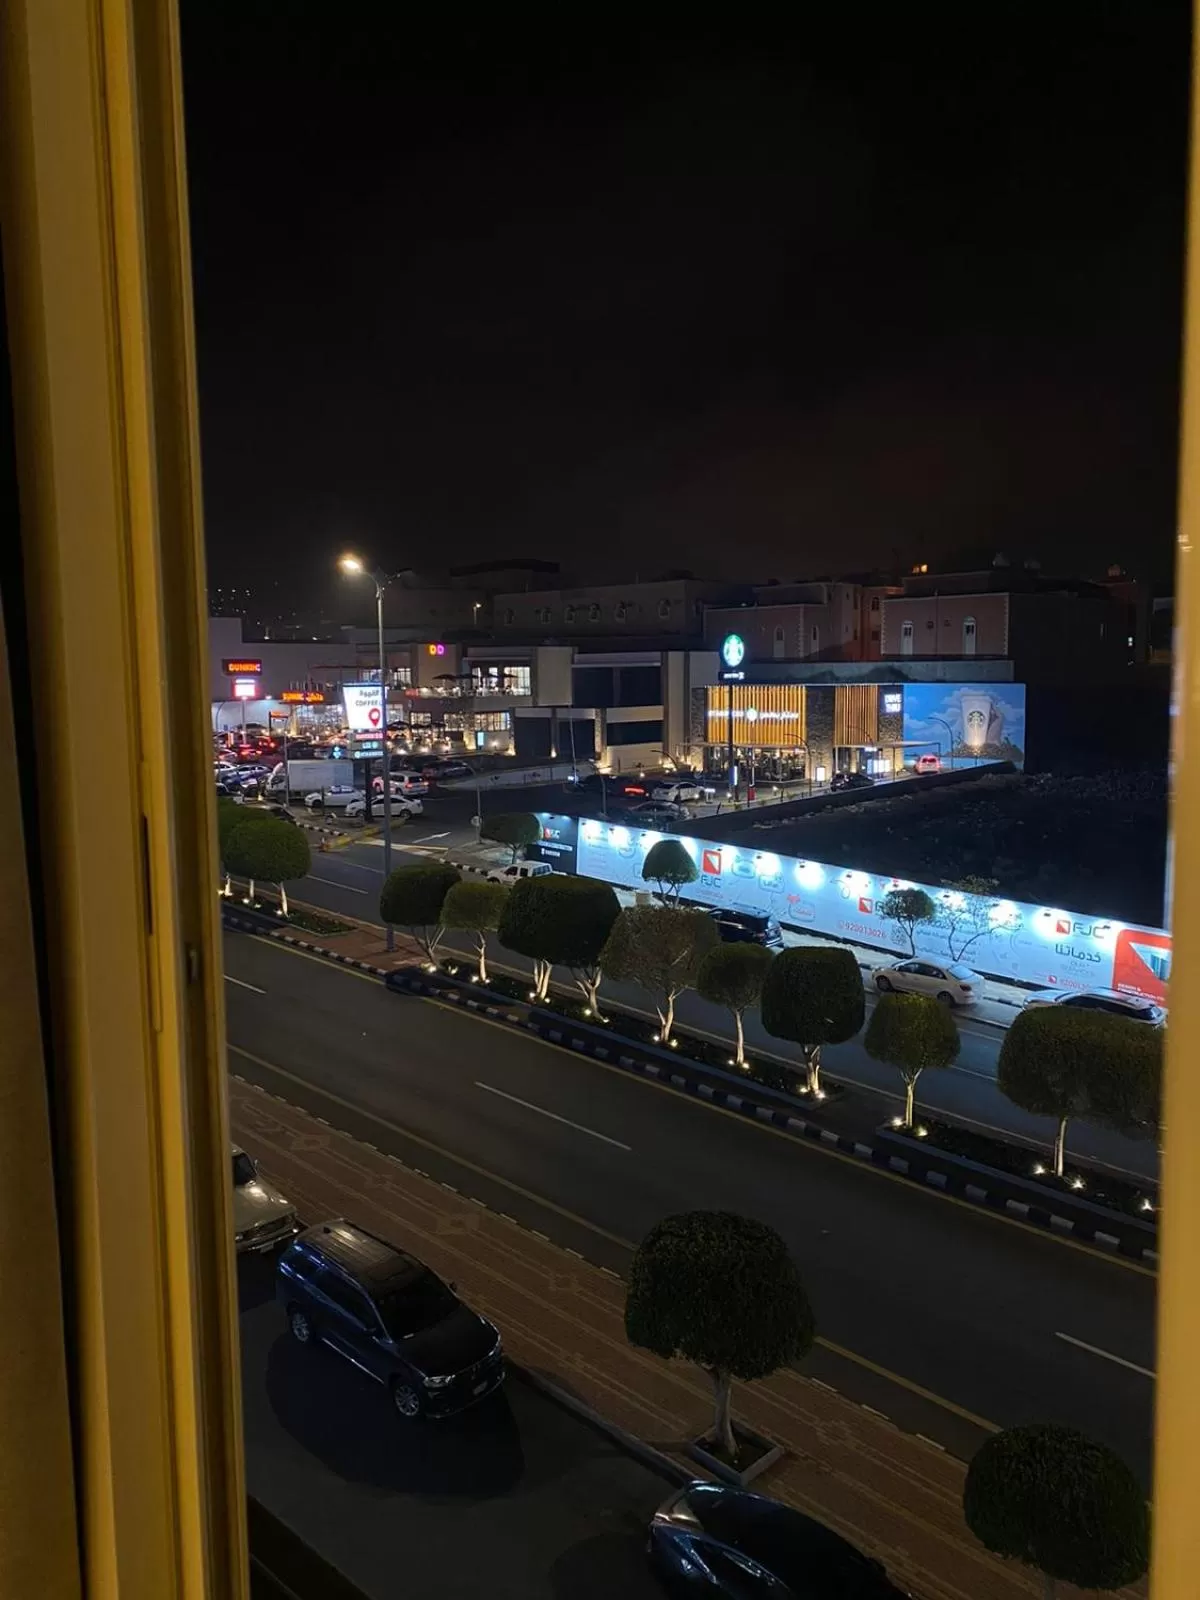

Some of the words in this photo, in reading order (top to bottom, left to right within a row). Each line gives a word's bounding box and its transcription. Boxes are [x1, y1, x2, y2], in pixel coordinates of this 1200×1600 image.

[700, 874, 723, 888] FJC
[1073, 922, 1105, 939] FJC
[1055, 943, 1101, 963] خدماتنا
